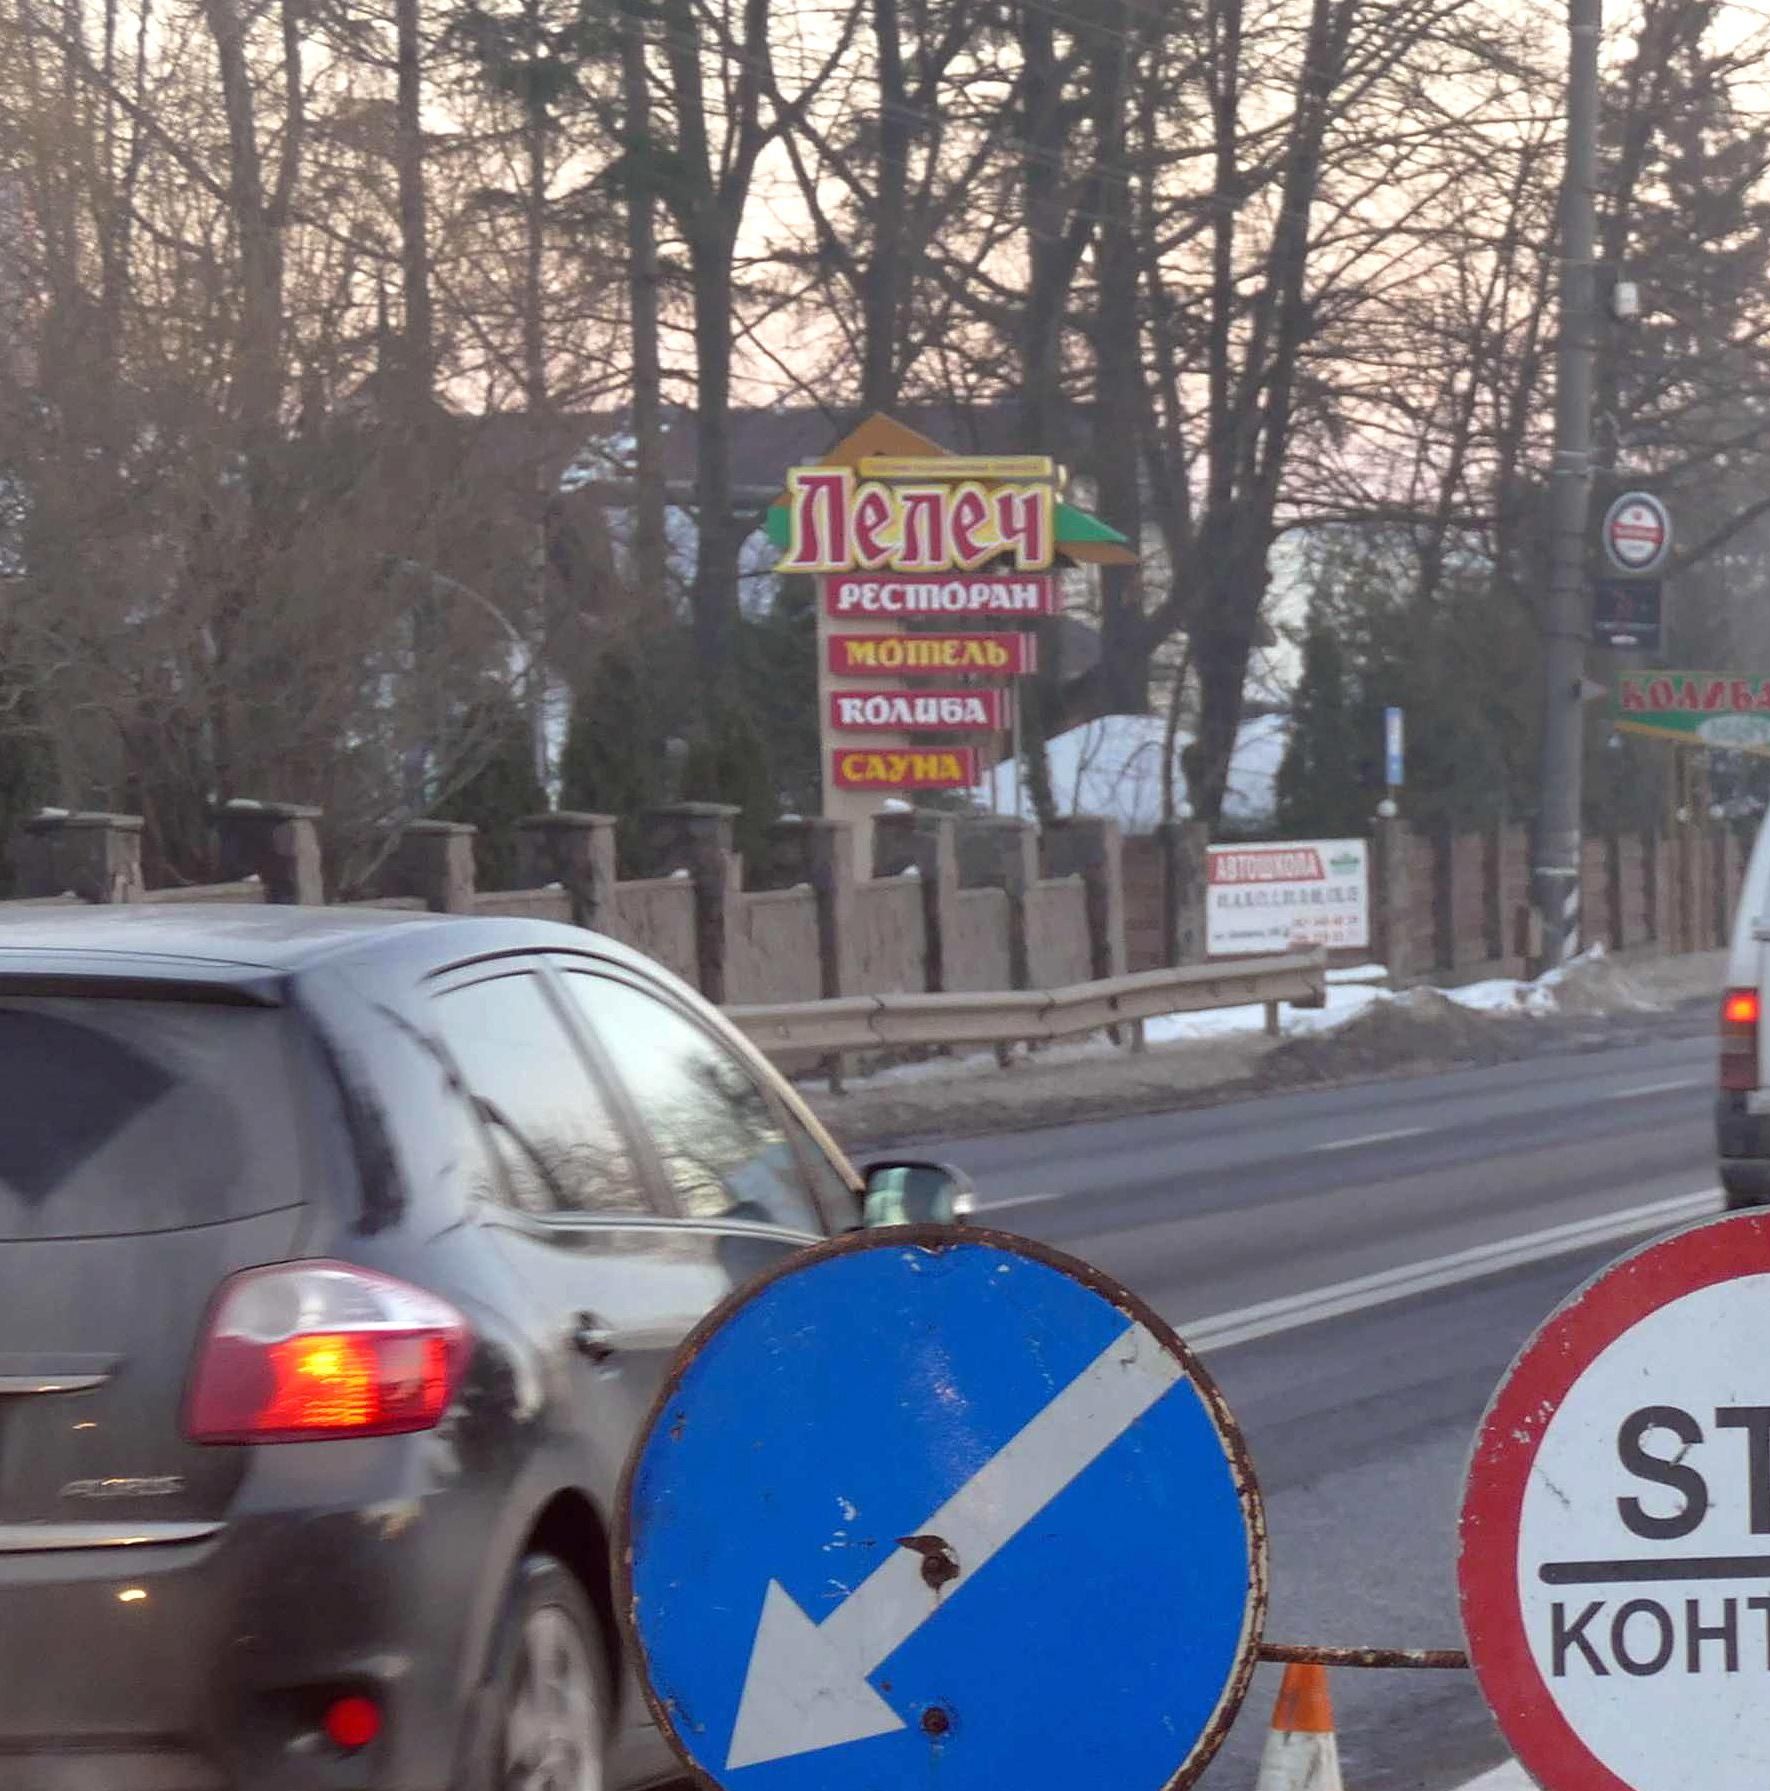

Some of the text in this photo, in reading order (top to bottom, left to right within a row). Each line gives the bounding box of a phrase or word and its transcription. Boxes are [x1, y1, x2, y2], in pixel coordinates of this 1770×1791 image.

[837, 582, 1039, 610] РЕСТОРАН
[845, 638, 1008, 667] МОТЕЛЬ
[838, 696, 987, 724] КОЛИБА
[842, 754, 962, 782] САУНА
